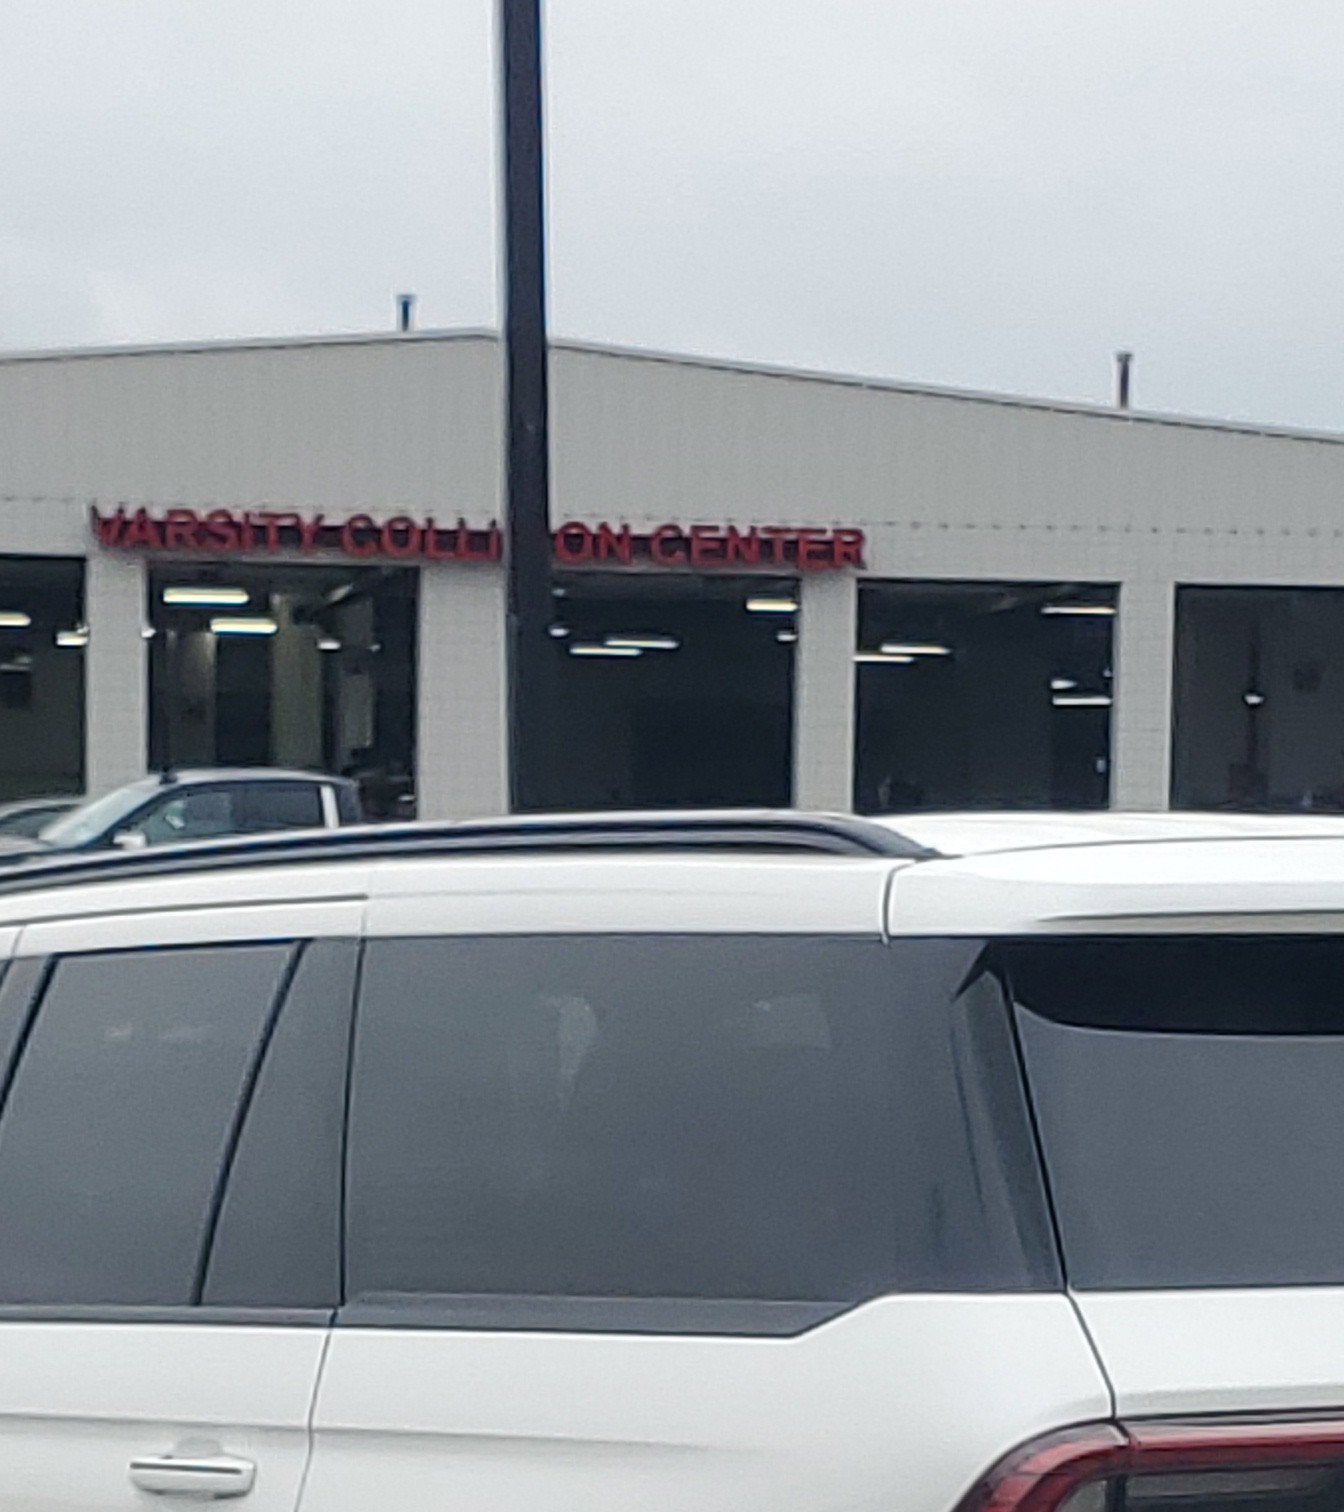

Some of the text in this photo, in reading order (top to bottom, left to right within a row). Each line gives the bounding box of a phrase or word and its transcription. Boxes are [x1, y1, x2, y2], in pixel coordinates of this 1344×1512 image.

[91, 505, 866, 571] VARSITY COLLION CENTER
